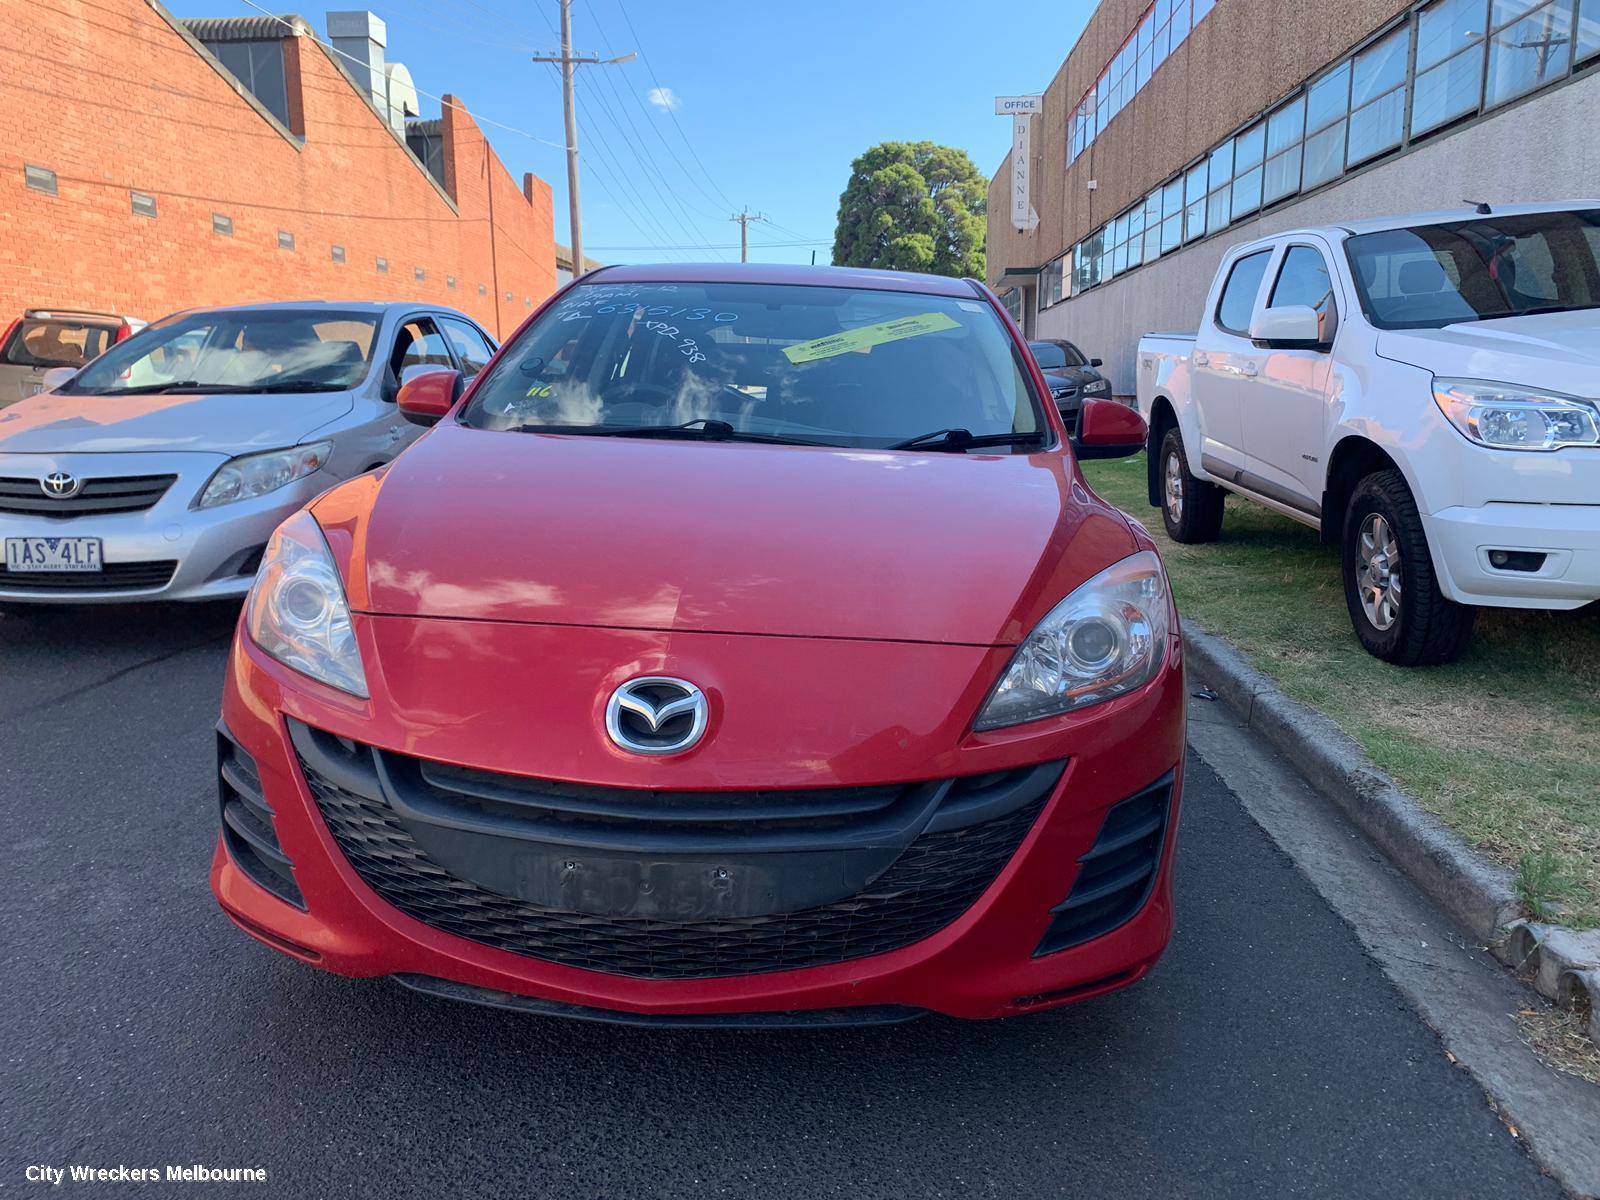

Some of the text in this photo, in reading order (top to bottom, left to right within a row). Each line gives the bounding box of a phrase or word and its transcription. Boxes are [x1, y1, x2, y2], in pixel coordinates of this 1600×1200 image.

[1004, 101, 1035, 109] OFFICE
[1017, 125, 1026, 209] DIANNE
[11, 542, 96, 563] 1AS 4LF
